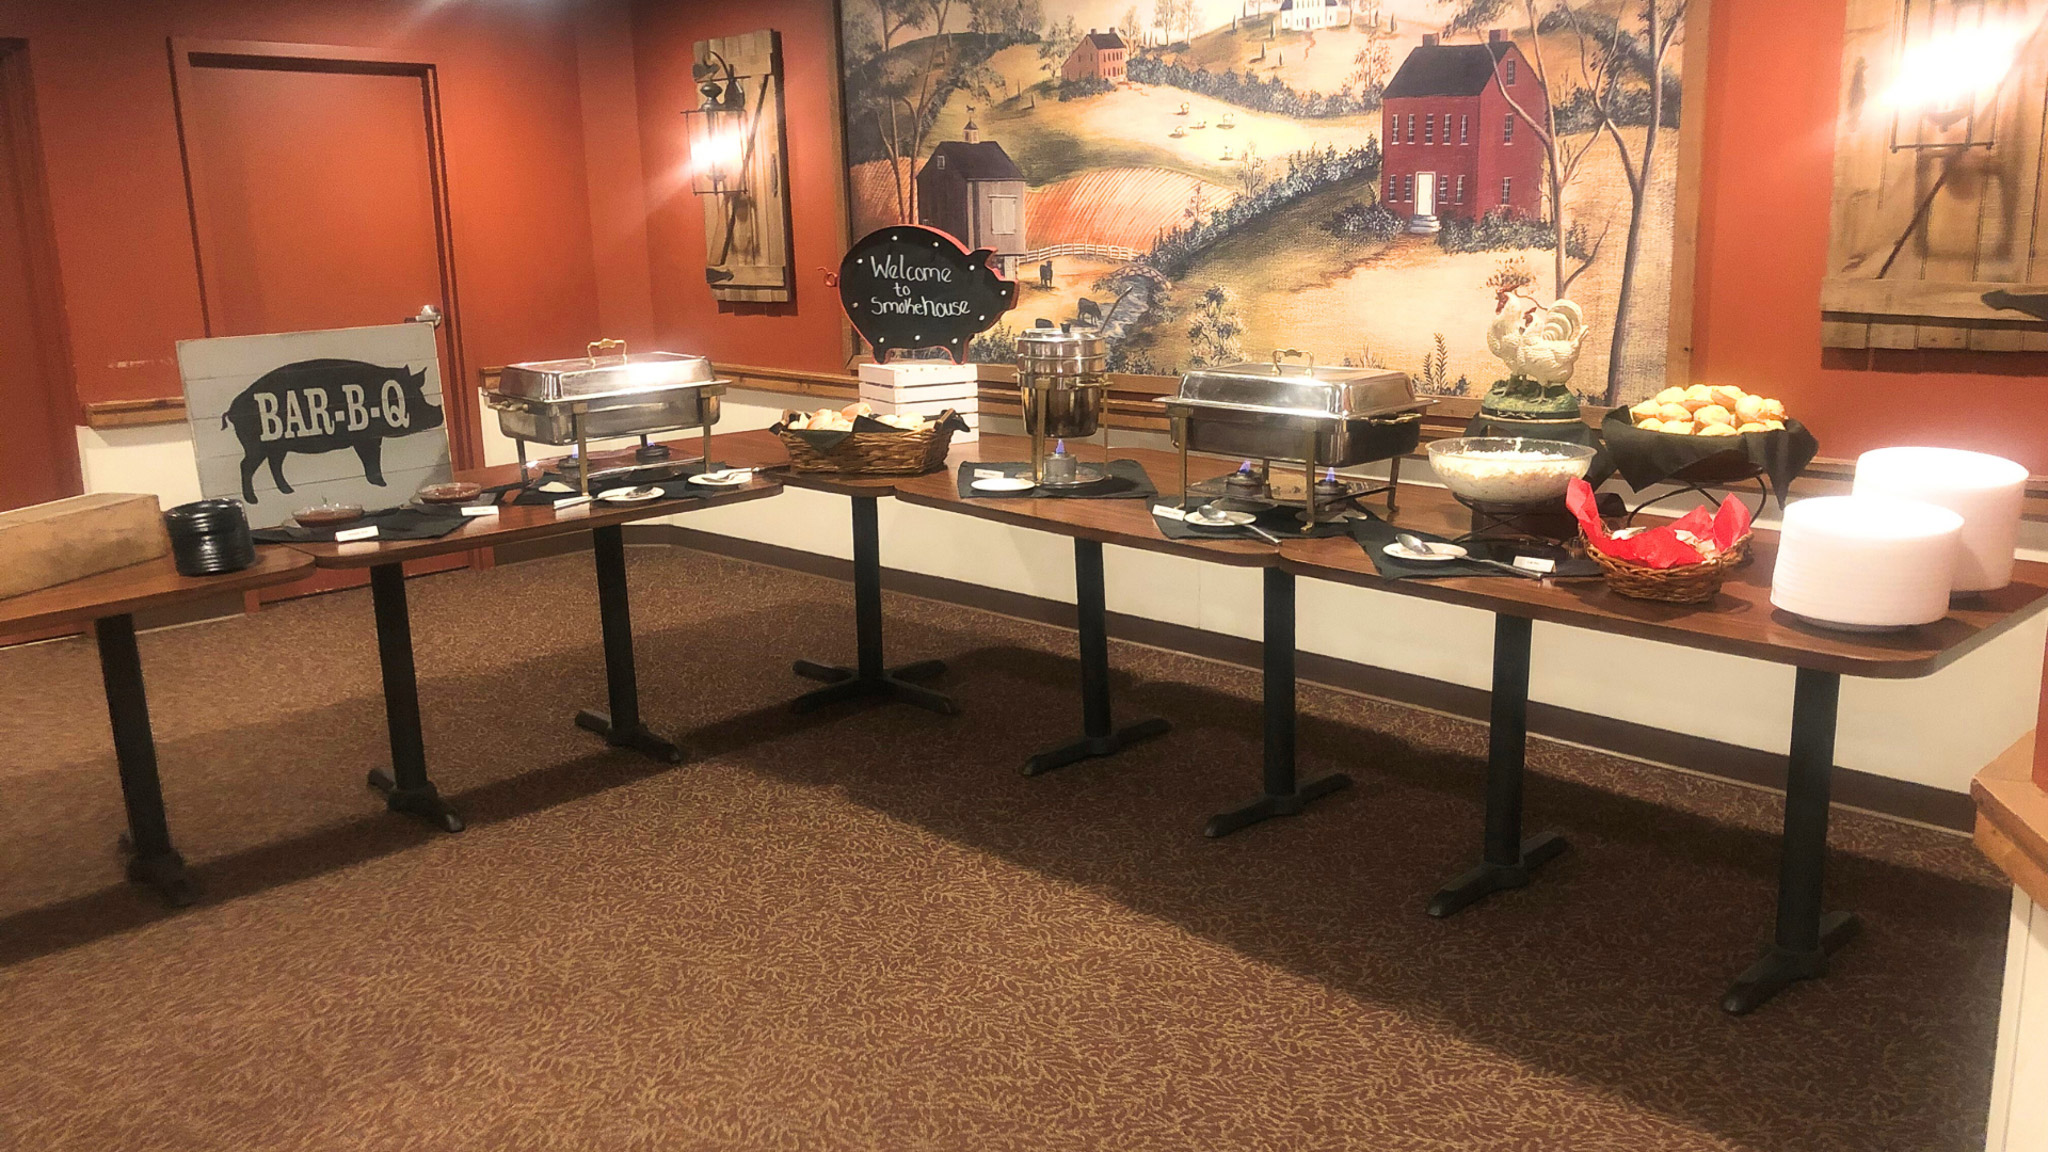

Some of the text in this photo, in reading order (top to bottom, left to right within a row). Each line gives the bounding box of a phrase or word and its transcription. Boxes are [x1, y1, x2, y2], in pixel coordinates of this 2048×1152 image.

[871, 254, 952, 282] Welcome
[894, 283, 911, 296] to
[254, 379, 410, 442] BAR-B-Q
